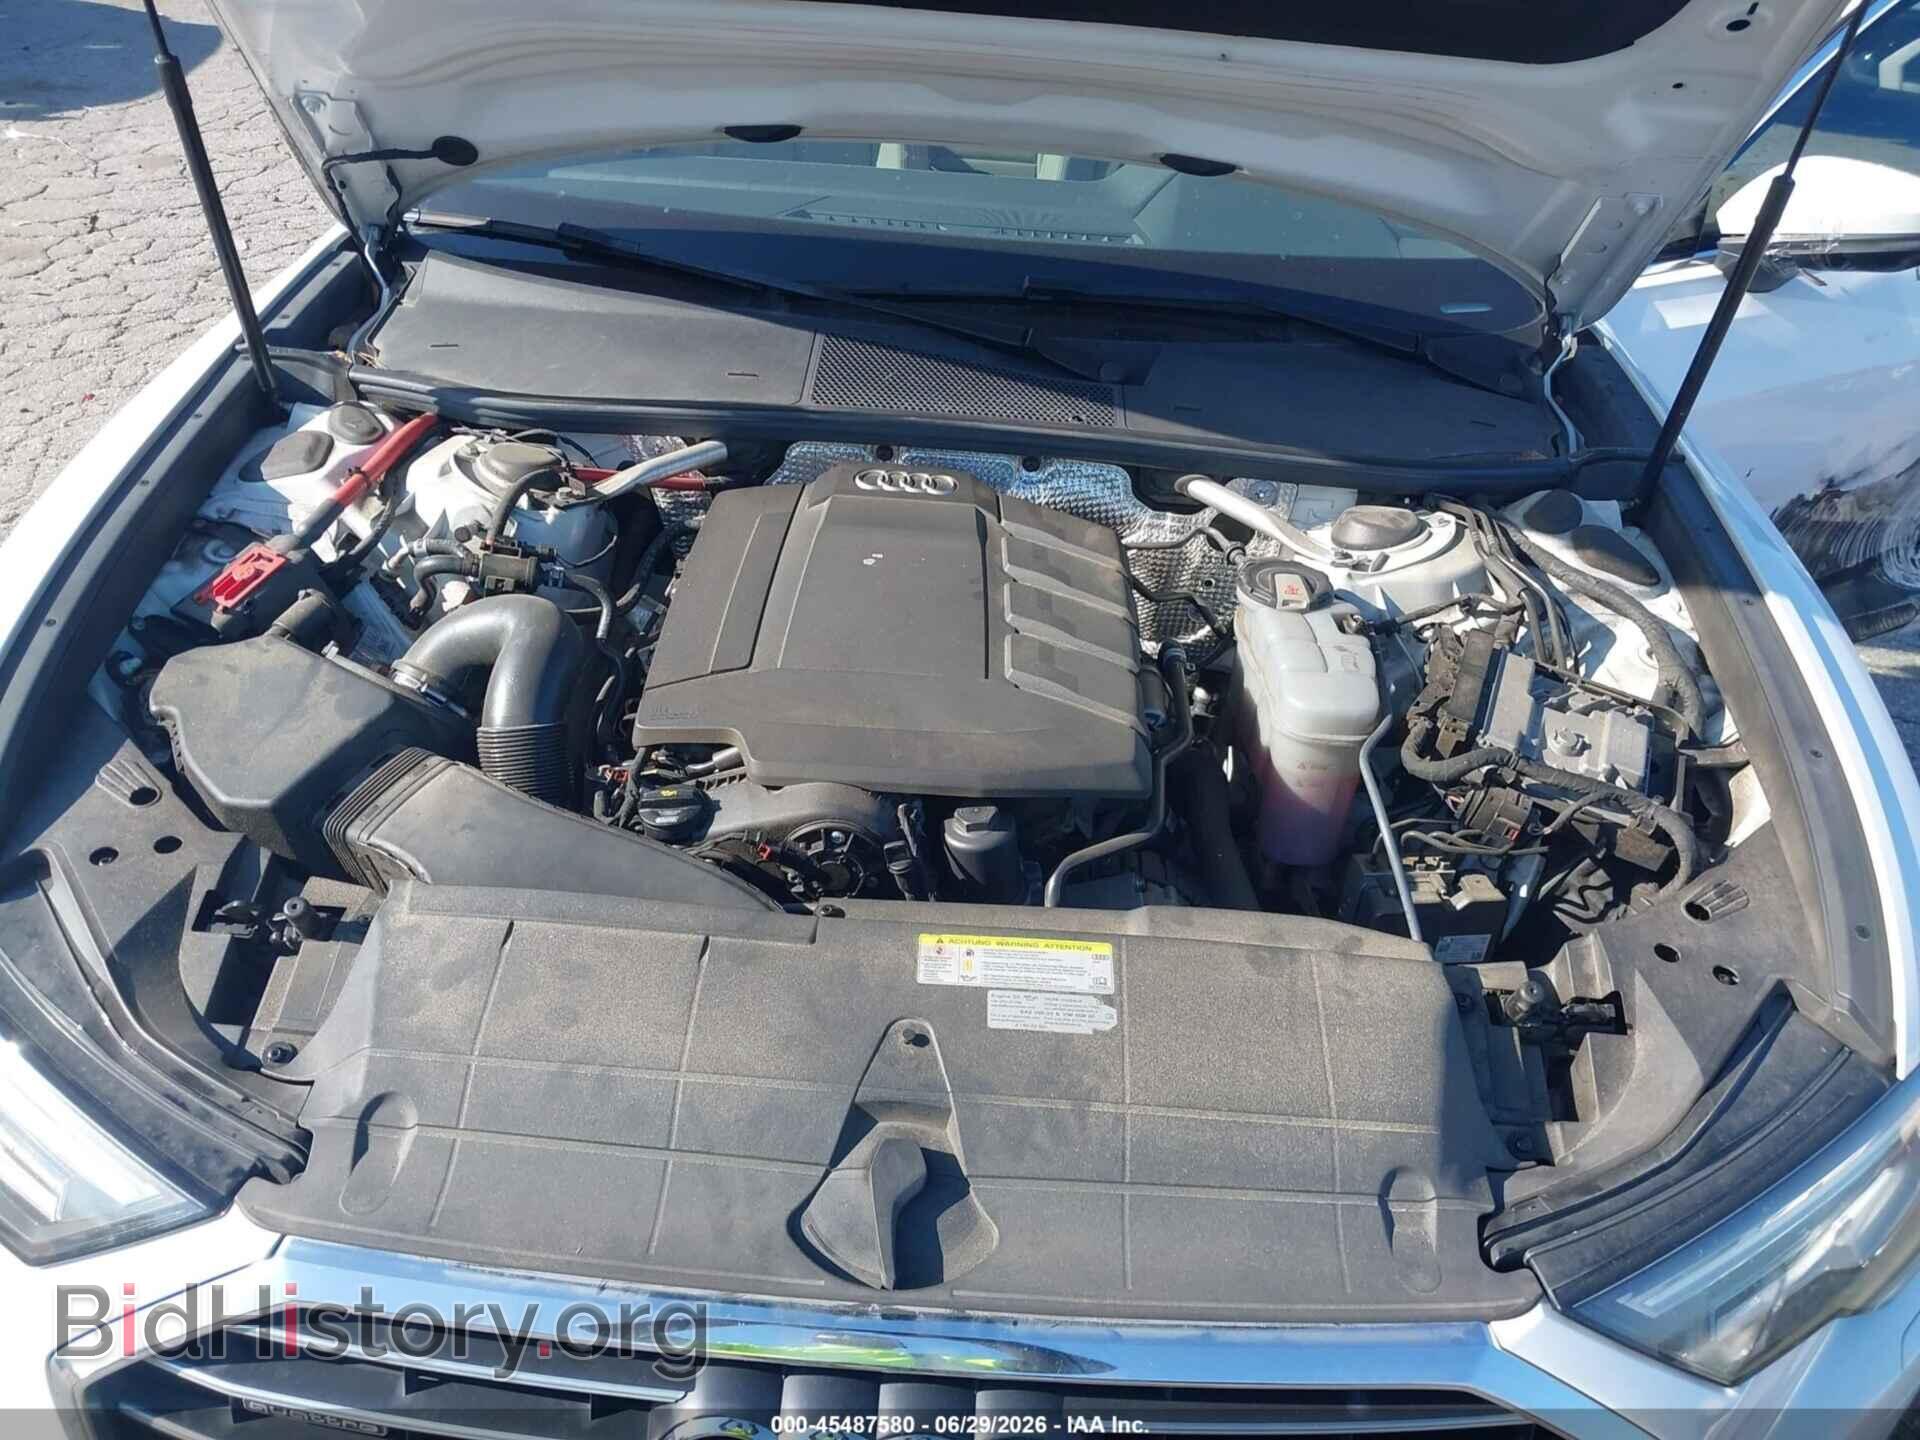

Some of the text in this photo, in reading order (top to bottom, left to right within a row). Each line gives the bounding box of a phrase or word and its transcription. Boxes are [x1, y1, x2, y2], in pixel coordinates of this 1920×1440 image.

[949, 937, 1093, 952] ACHTUNG WARNING ATTENTION
